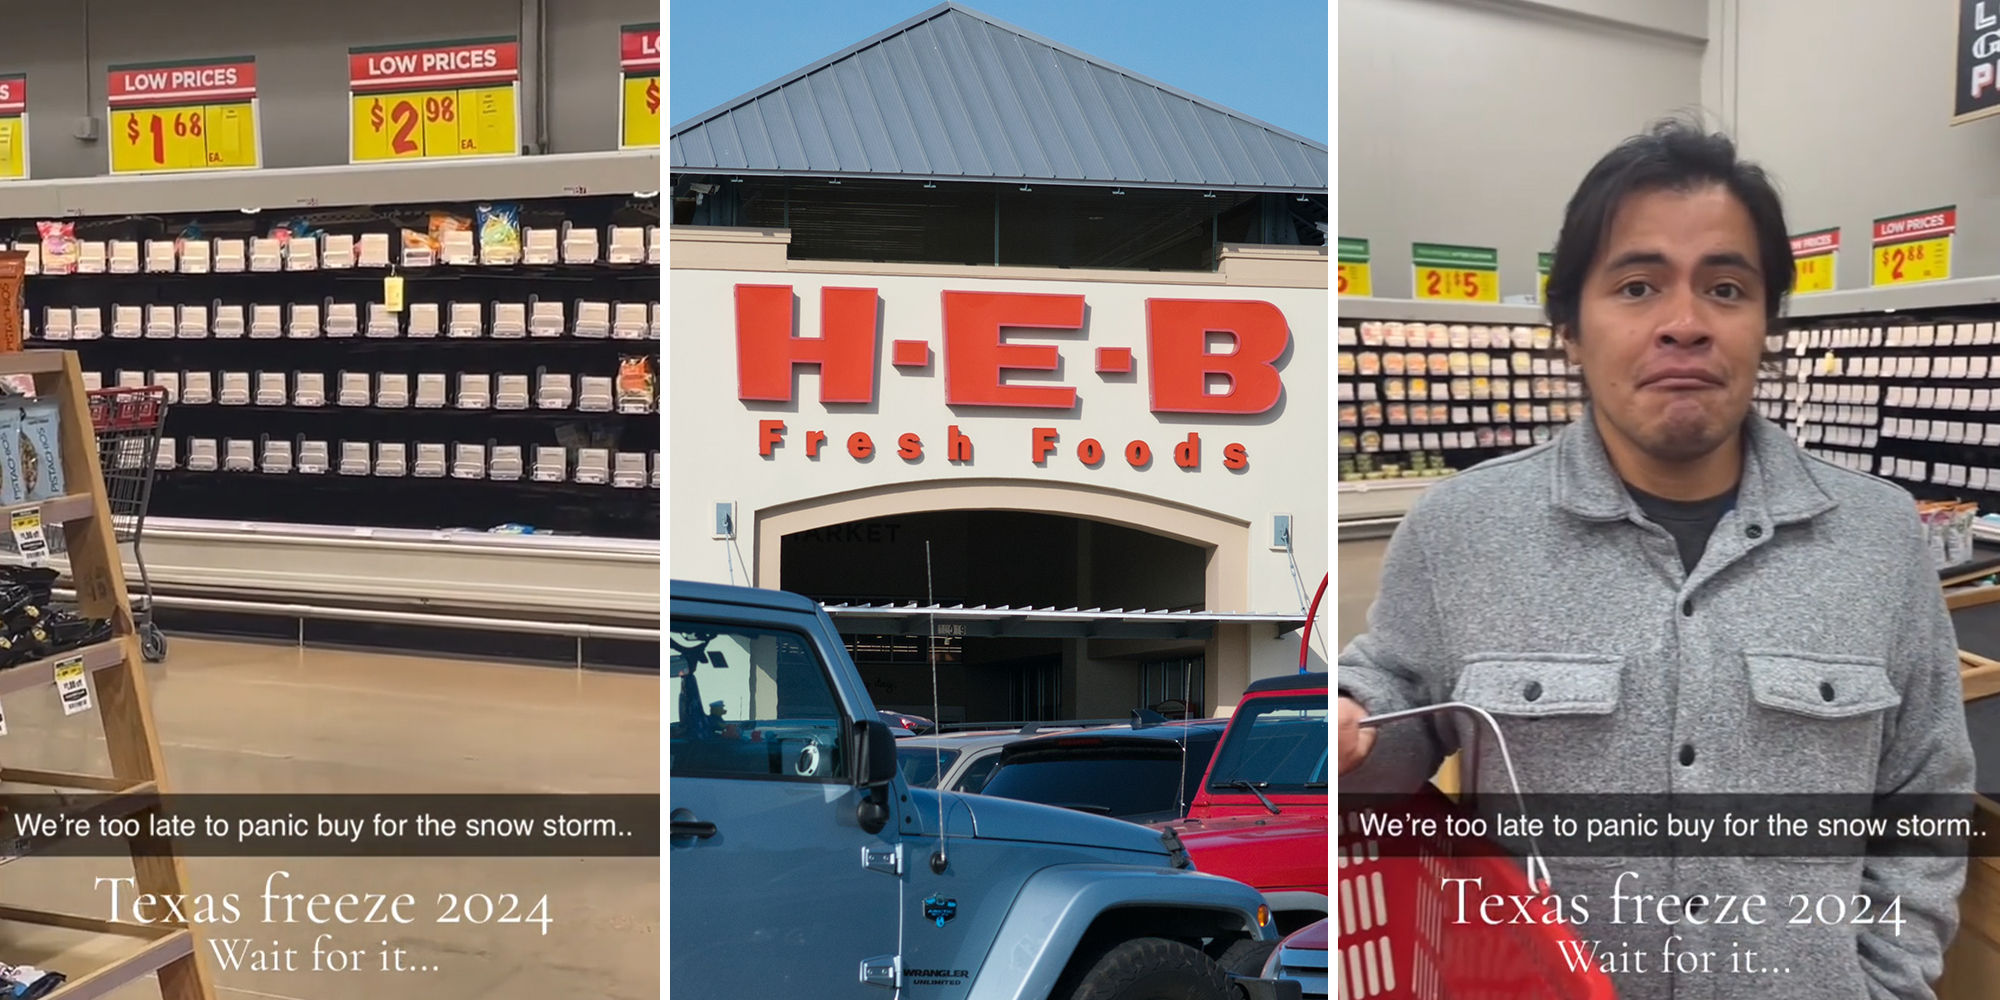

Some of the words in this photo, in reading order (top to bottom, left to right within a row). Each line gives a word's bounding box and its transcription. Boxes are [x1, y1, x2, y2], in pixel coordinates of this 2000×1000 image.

[369, 54, 416, 76] LOW
[423, 49, 497, 72] PRICES
[125, 72, 171, 91] LOW
[172, 68, 237, 89] PRICES
[1881, 220, 1906, 235] LOW
[1907, 214, 1945, 231] PRICES
[1426, 270, 1441, 295] 2
[733, 284, 1289, 413] H-E-B
[759, 419, 972, 461] Fresh
[1032, 428, 1248, 469] Foods
[37, 427, 59, 492] PISTACHIOS
[793, 523, 901, 542] ARKET
[903, 968, 969, 978] WRANGLER
